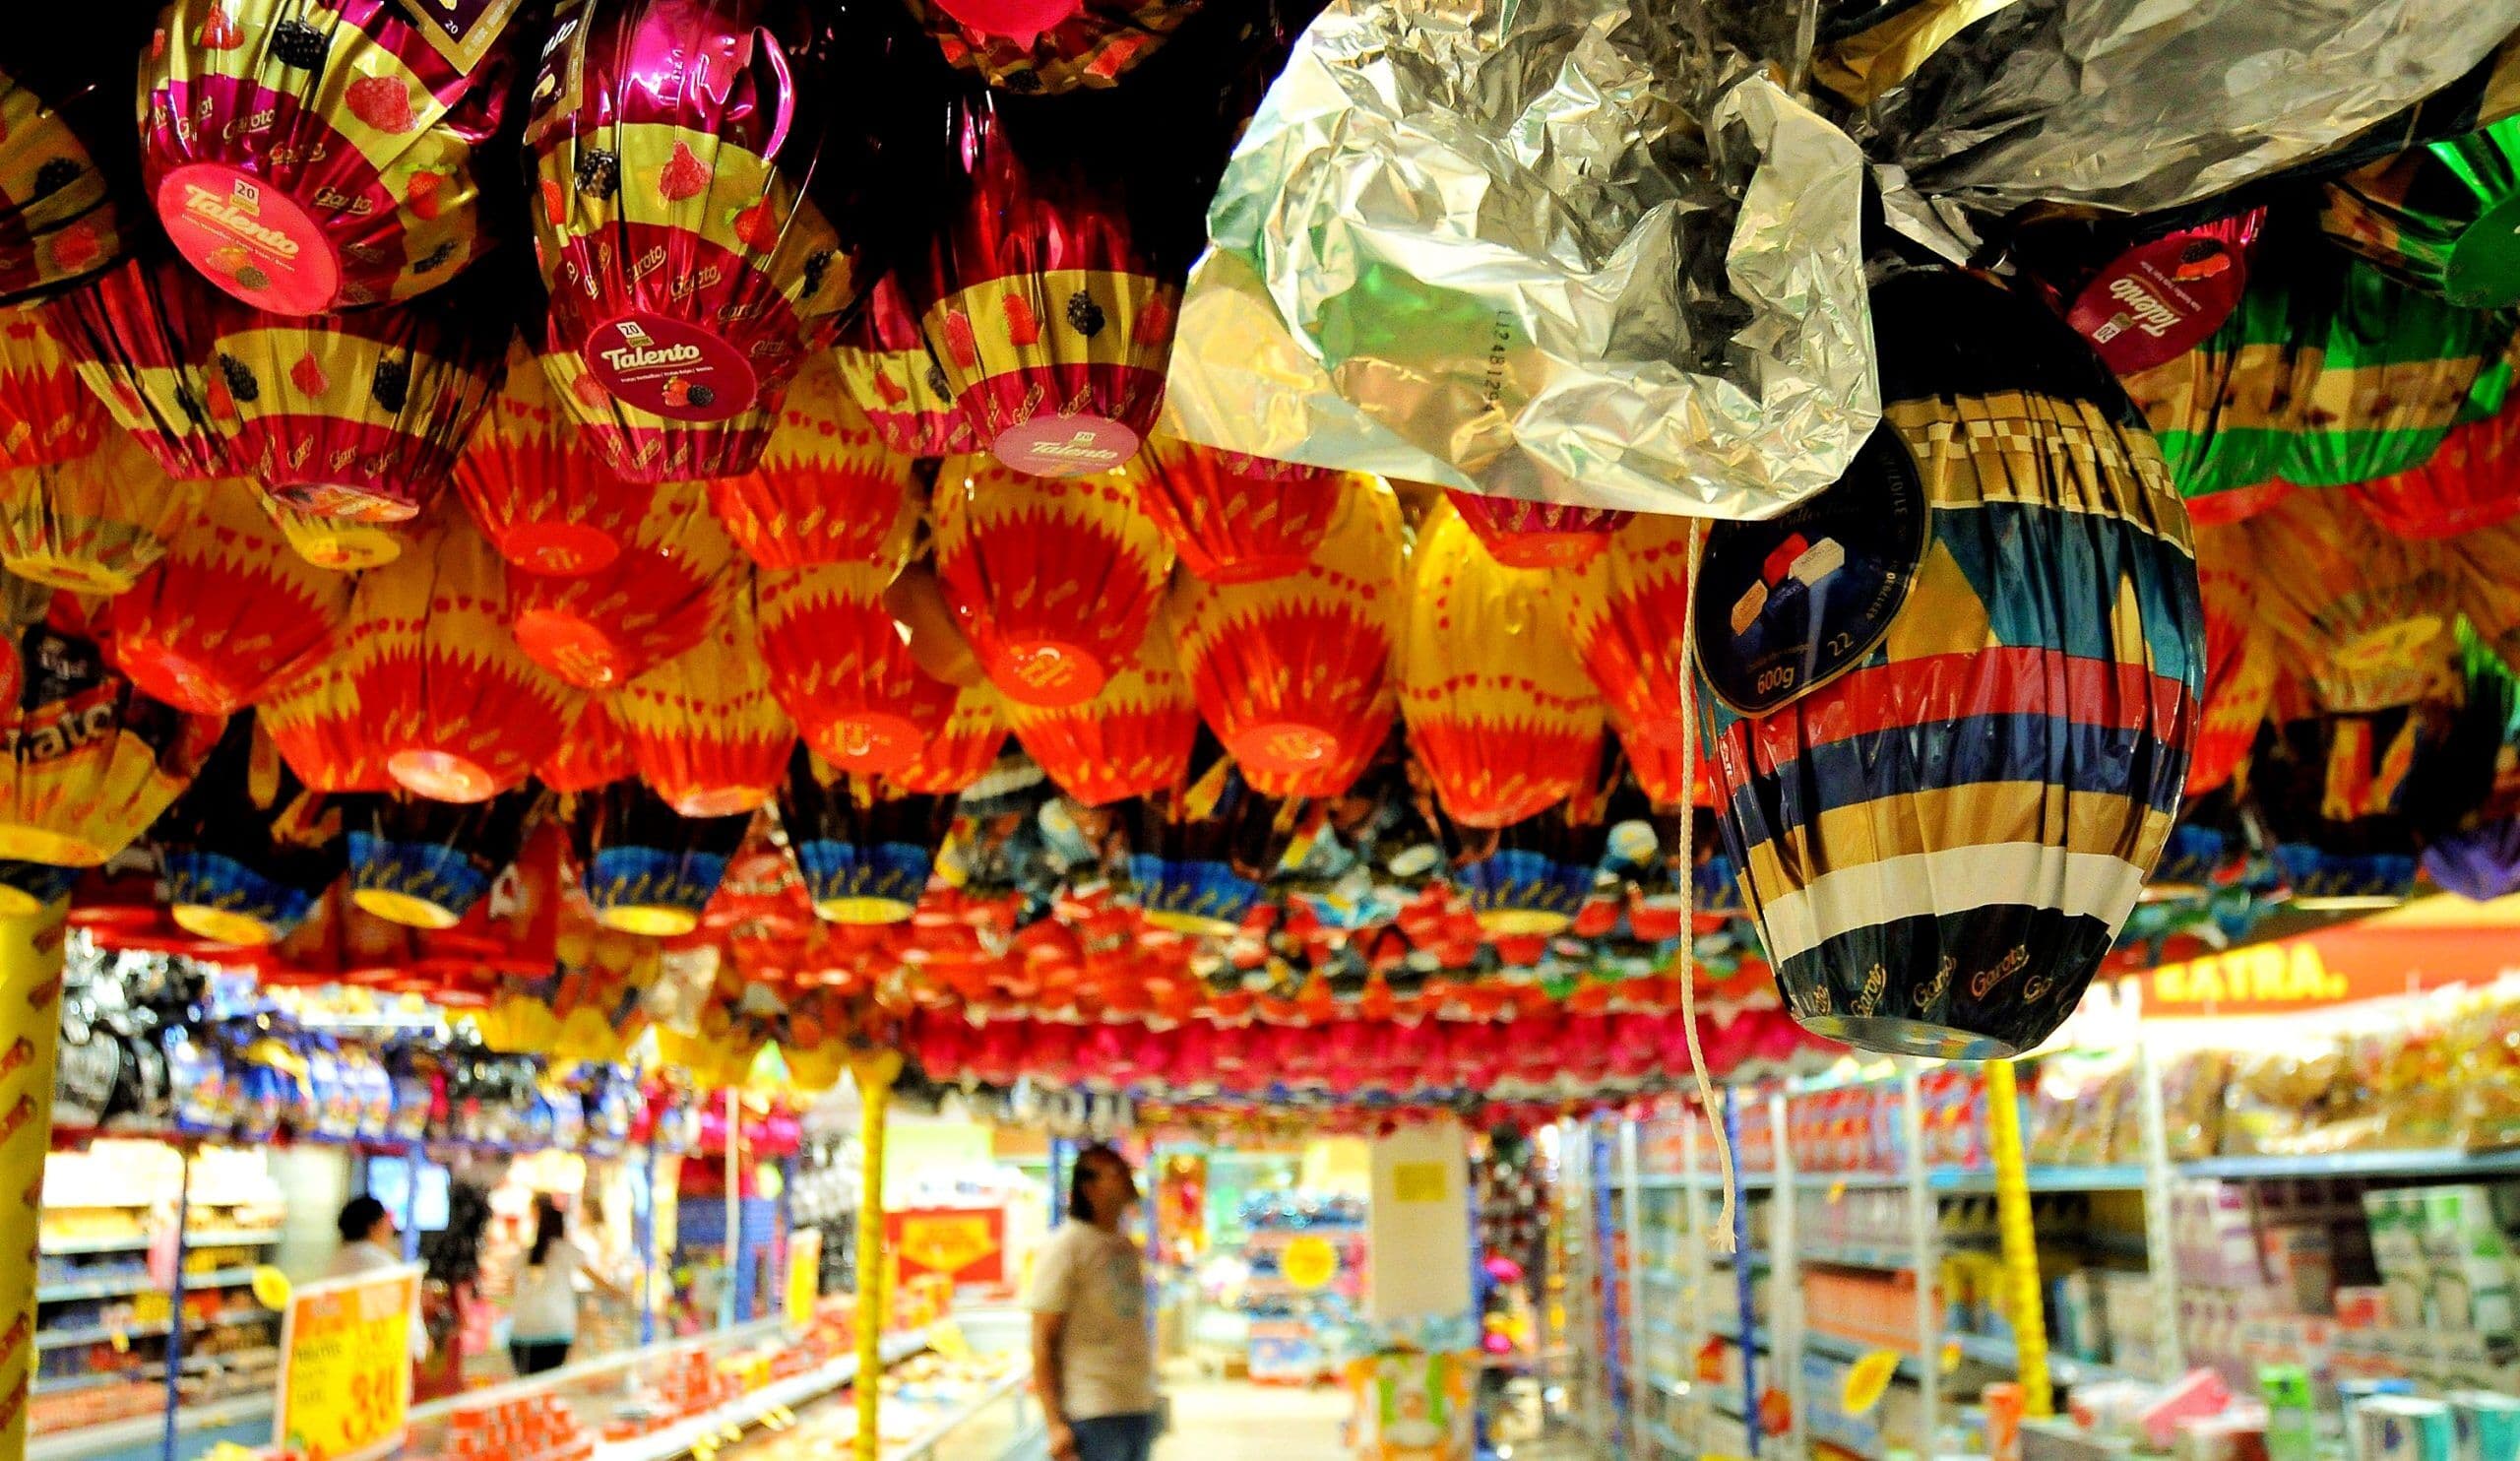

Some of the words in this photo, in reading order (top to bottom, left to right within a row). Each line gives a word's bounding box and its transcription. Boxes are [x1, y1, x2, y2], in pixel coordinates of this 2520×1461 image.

[444, 19, 460, 34] 20
[237, 182, 256, 200] 20
[184, 184, 299, 255] Talento
[2109, 278, 2182, 338] Talento
[620, 324, 640, 336] 20
[600, 343, 701, 371] Talento
[1827, 631, 1855, 657] 22
[1757, 667, 1796, 695] 600g
[1971, 944, 2031, 1002] Garoto
